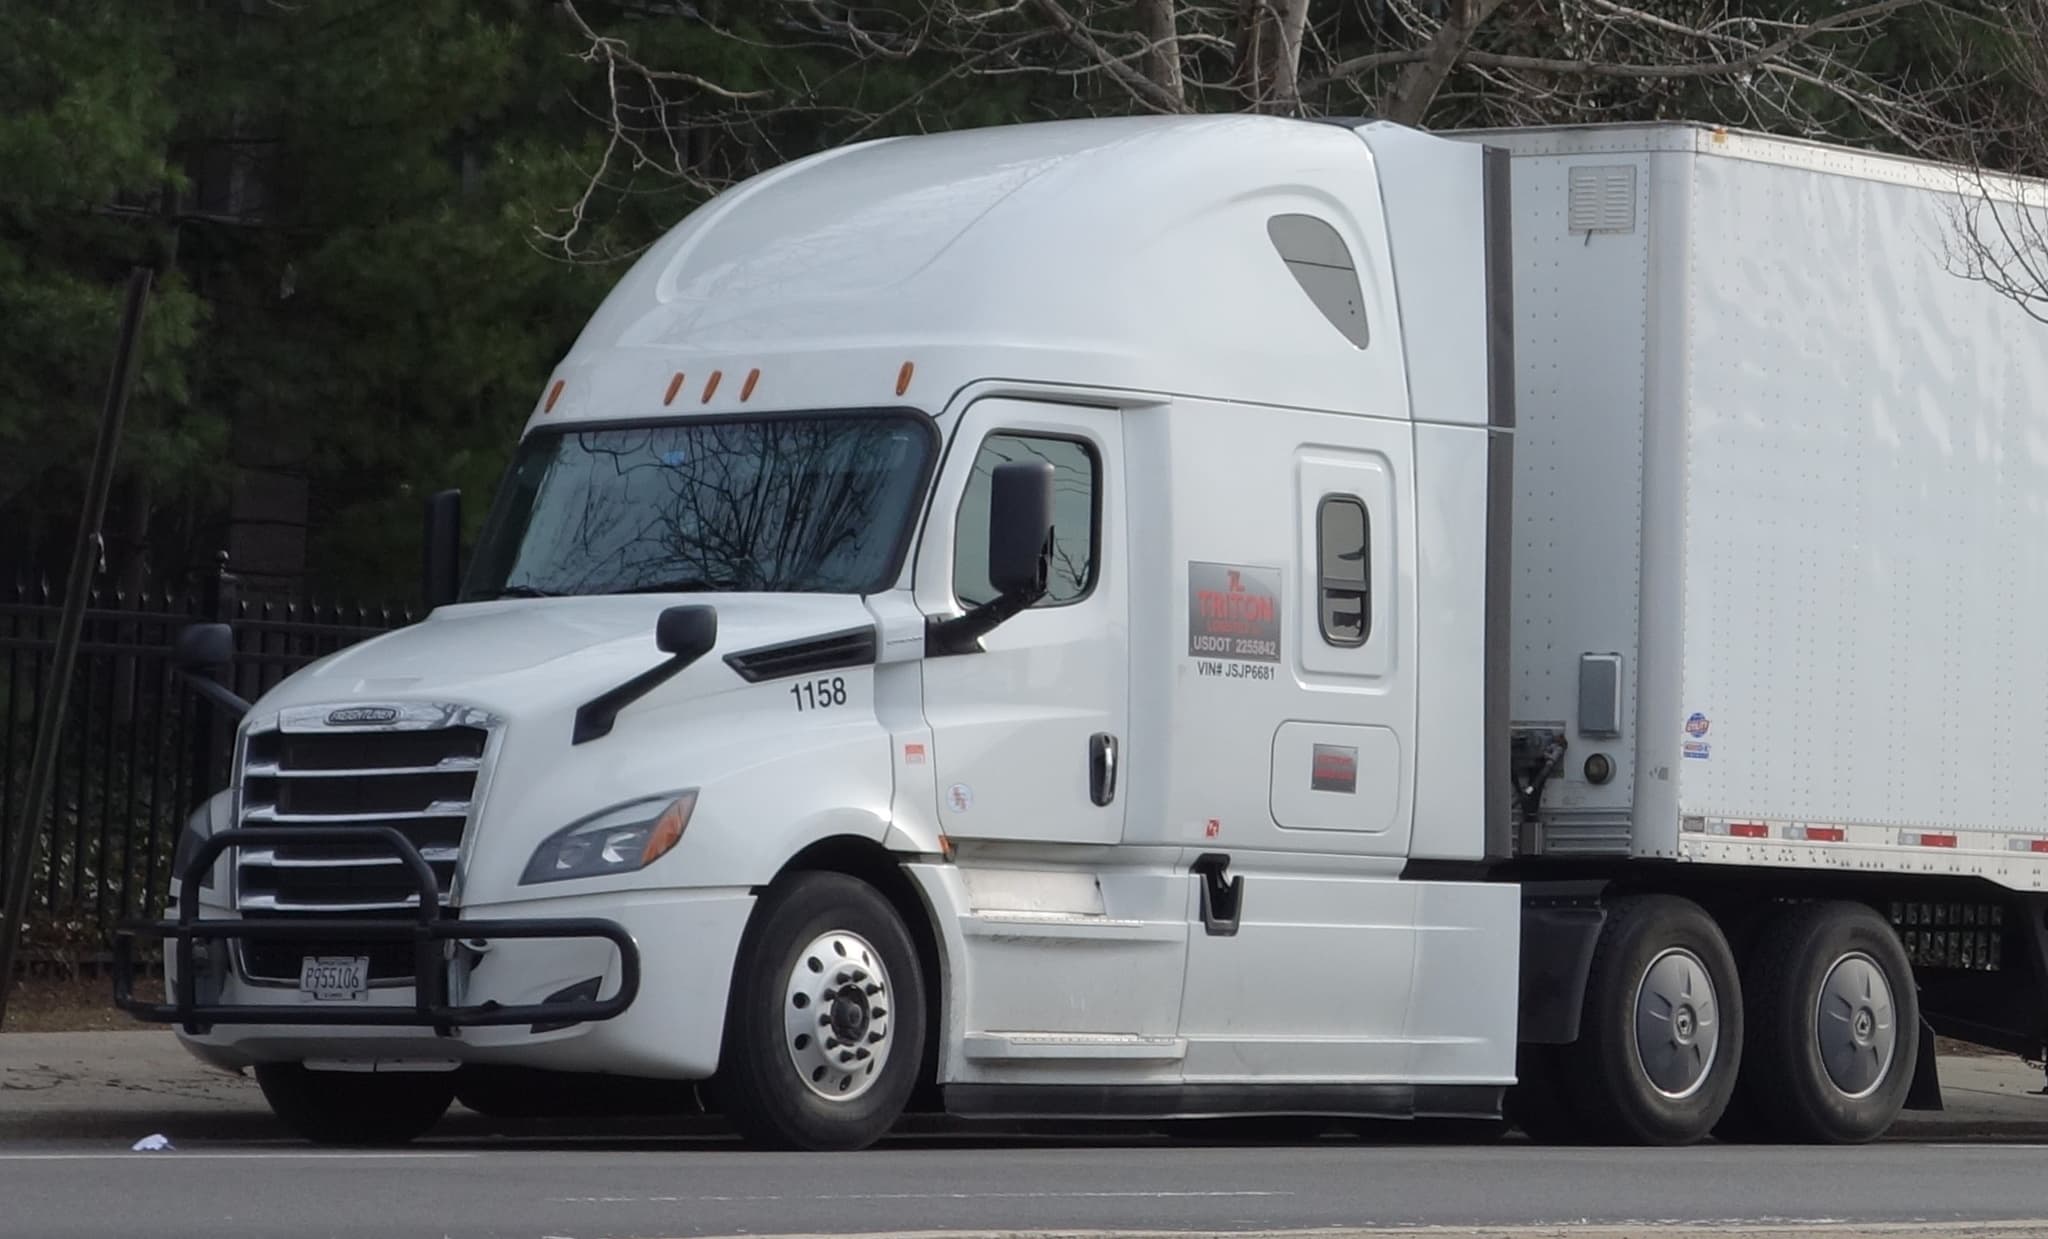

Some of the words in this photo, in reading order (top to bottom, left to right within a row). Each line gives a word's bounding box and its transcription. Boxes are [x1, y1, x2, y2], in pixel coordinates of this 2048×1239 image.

[1196, 589, 1274, 623] TRITON
[1193, 636, 1231, 652] USDOT
[1197, 661, 1222, 677] VIN#
[1225, 663, 1275, 680] JSJP6681
[790, 677, 847, 712] 1158
[305, 967, 359, 989] P955106
